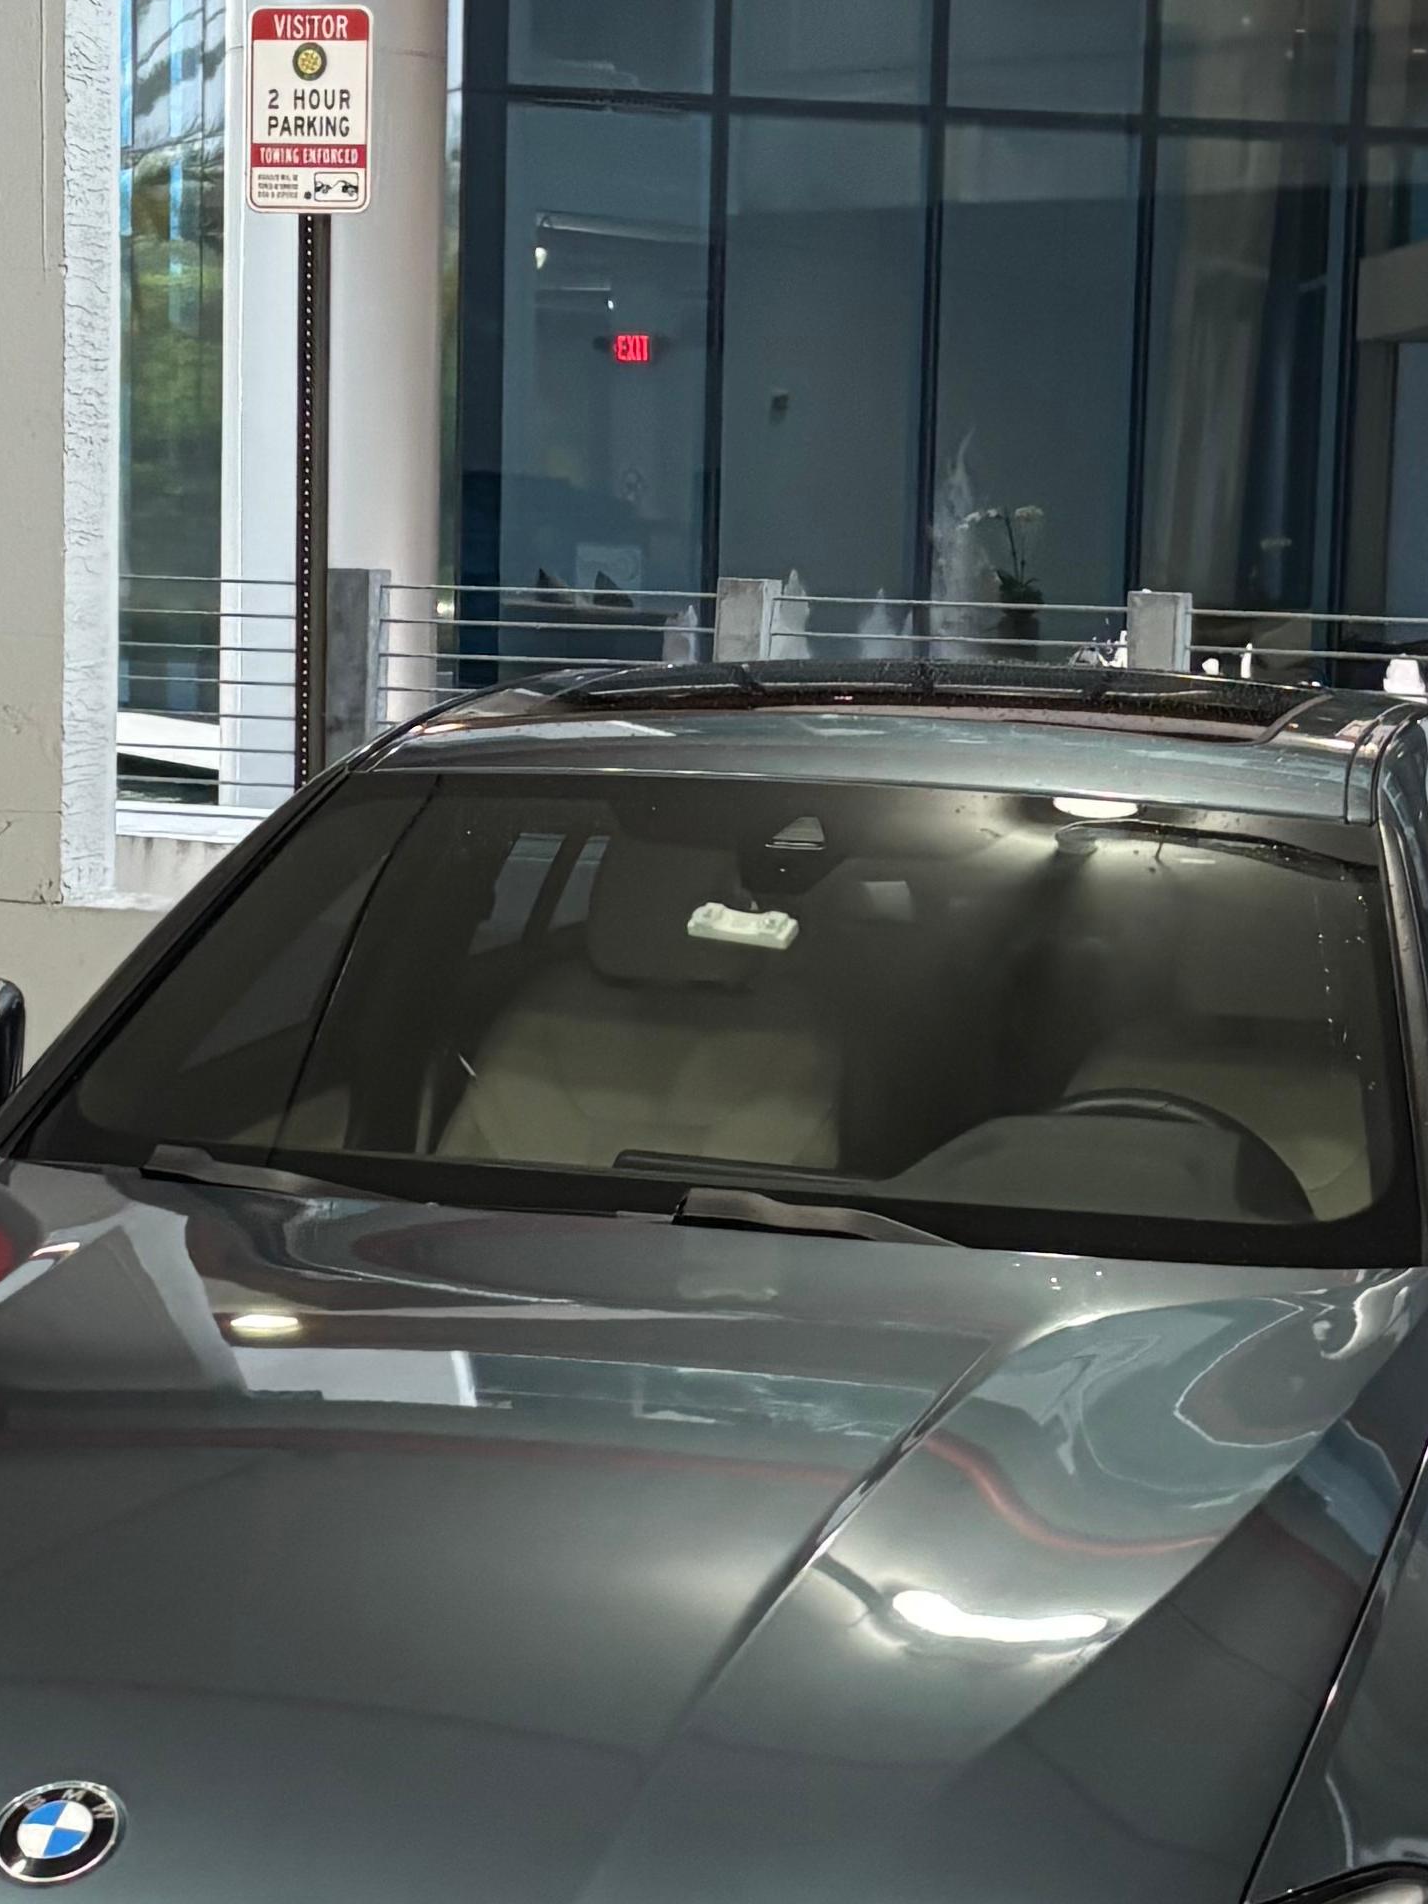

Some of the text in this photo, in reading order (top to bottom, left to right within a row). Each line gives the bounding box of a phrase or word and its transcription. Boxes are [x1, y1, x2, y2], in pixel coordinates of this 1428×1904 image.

[273, 14, 348, 39] VISITOR
[268, 88, 351, 110] 2 HOUR
[267, 115, 350, 137] PARKING
[259, 147, 359, 165] TOWING ENFORCED
[617, 335, 649, 361] EXIT
[23, 1787, 116, 1820] BMW
